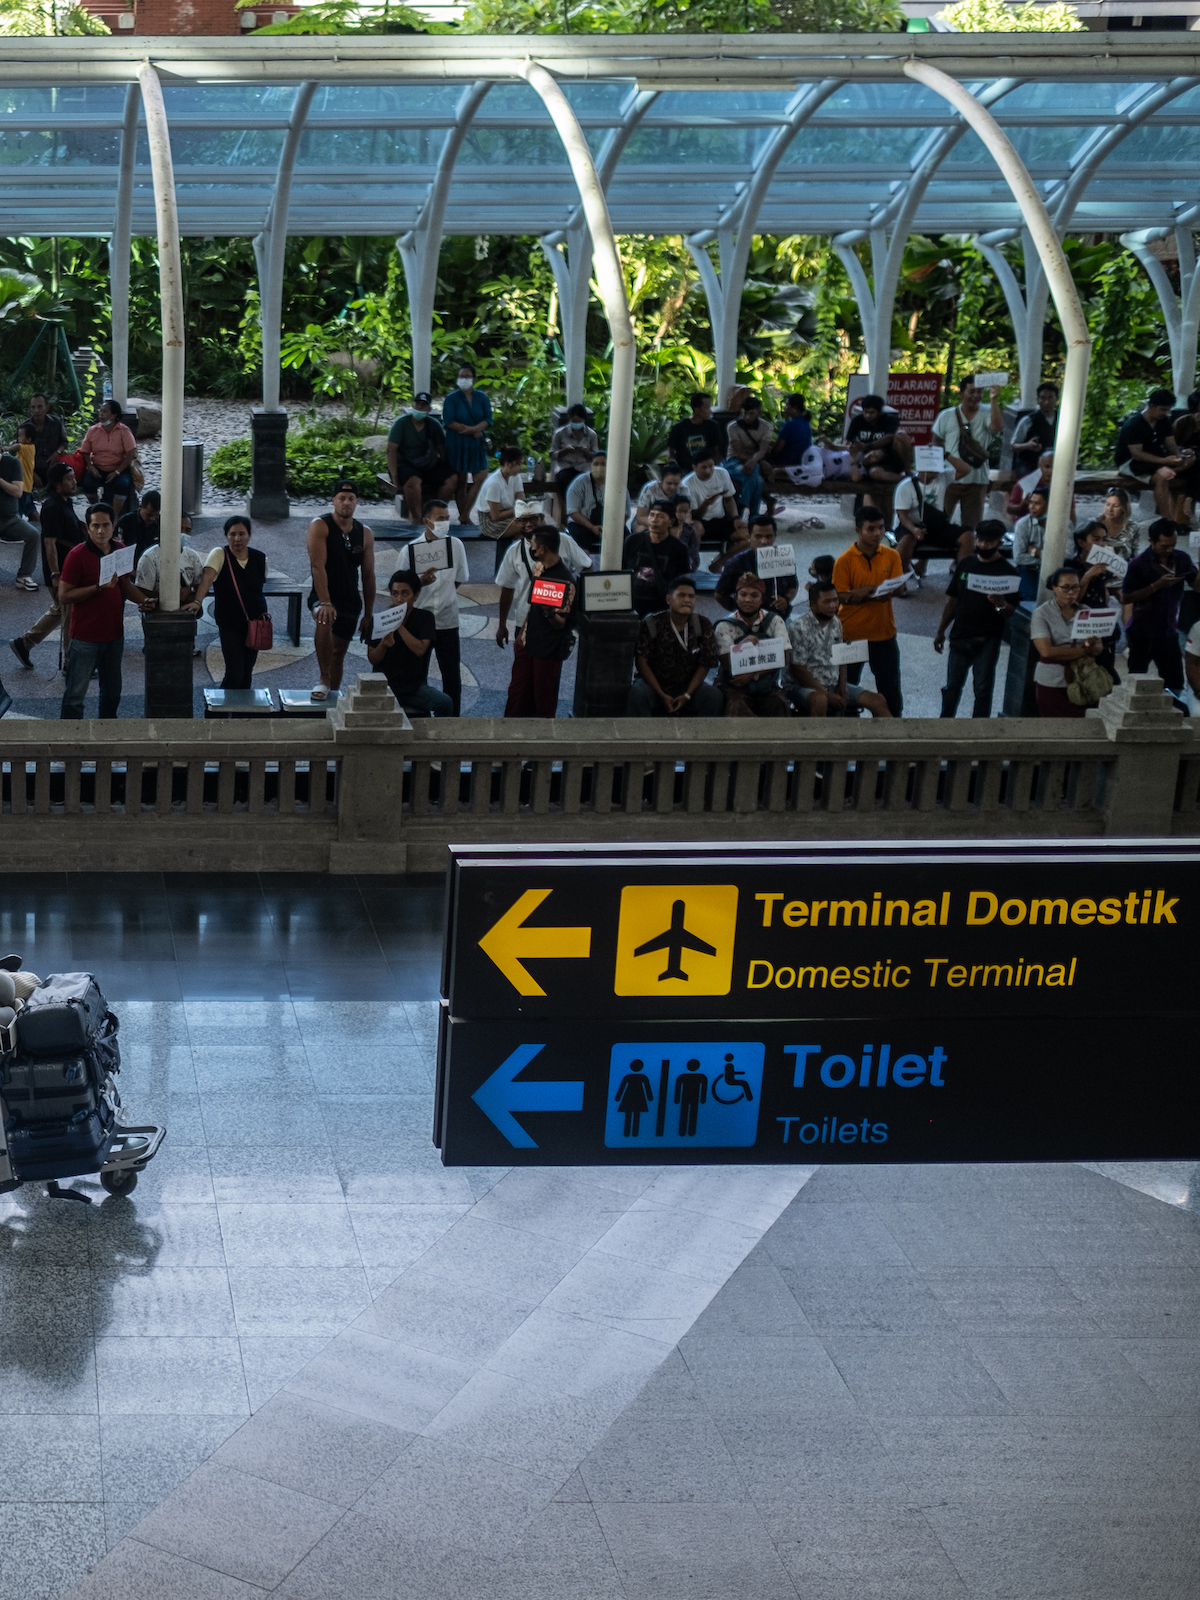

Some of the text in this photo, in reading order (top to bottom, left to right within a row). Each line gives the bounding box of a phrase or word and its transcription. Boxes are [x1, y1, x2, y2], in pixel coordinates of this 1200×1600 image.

[415, 550, 445, 563] COMO
[533, 587, 564, 599] INDIGO
[755, 890, 1180, 928] Terminal Domestik
[747, 958, 1078, 990] Domestic Terminal
[783, 1044, 949, 1089] Toilet
[776, 1117, 890, 1145] Toilets
